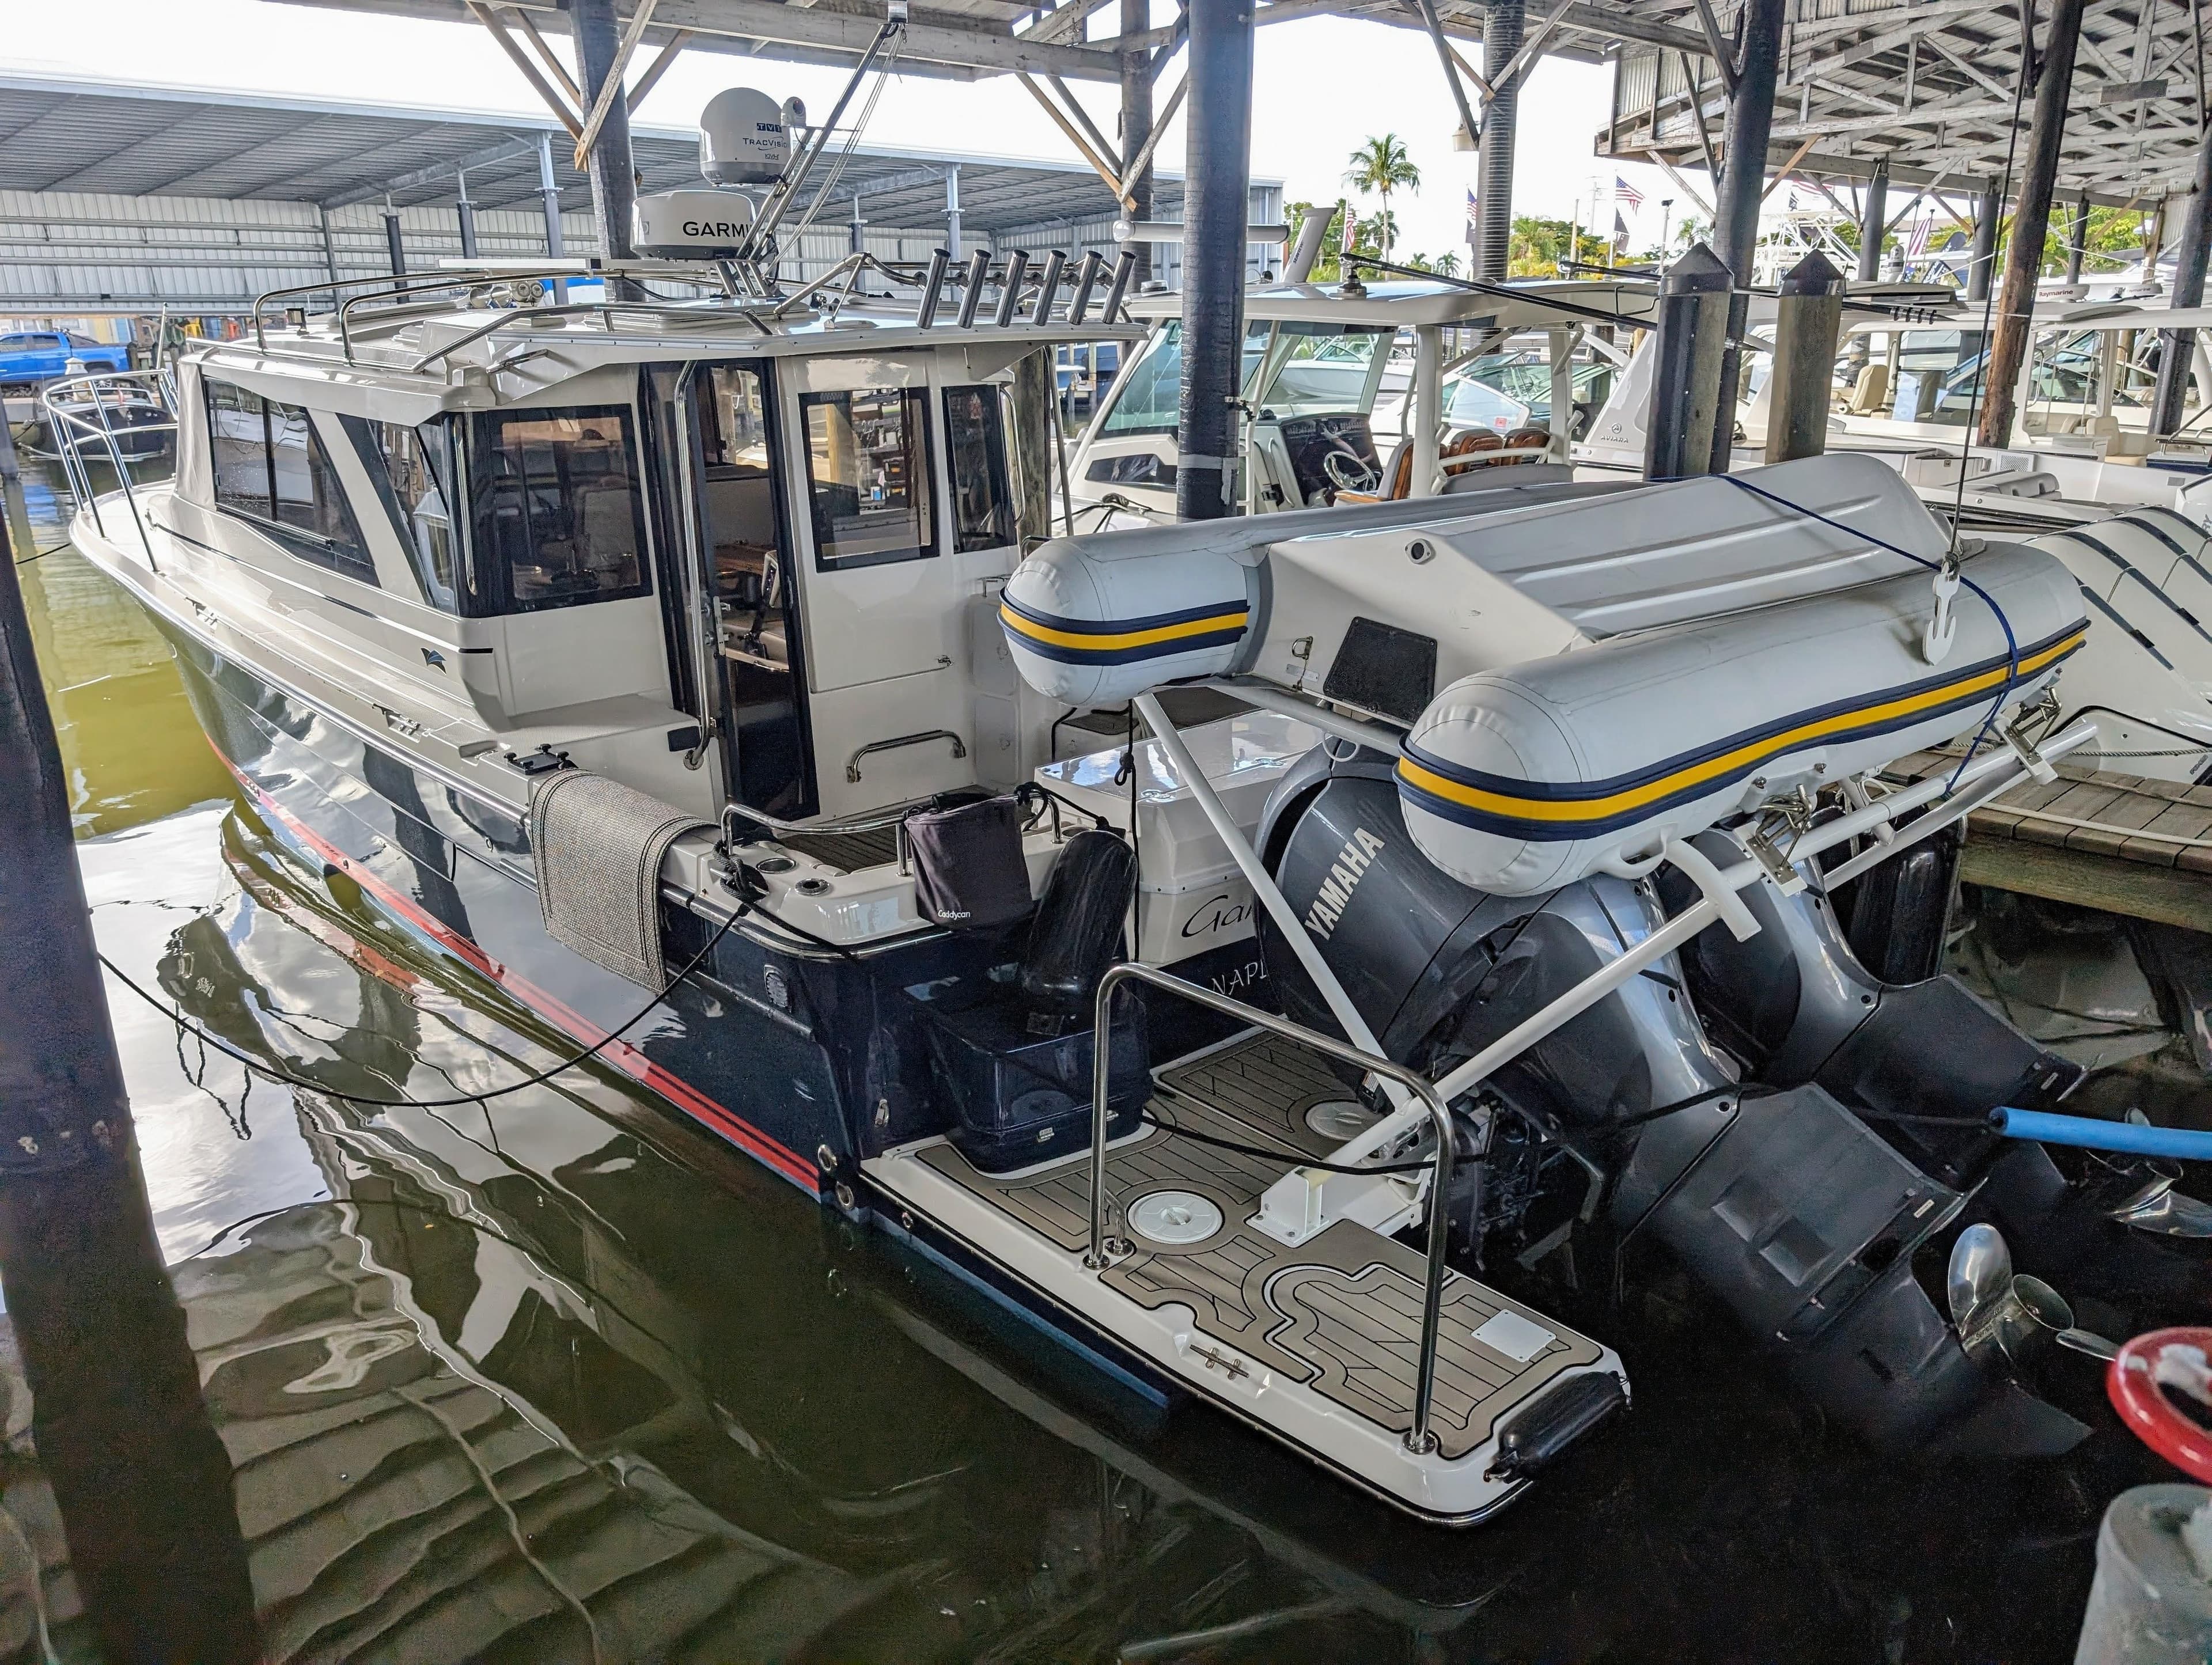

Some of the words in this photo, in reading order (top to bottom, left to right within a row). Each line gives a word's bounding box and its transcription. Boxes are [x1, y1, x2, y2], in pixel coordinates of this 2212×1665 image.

[683, 221, 752, 238] GARMI
[2039, 290, 2073, 298] Raymarine
[1305, 827, 1385, 940] YAMAHA
[938, 909, 971, 920] Caddycan
